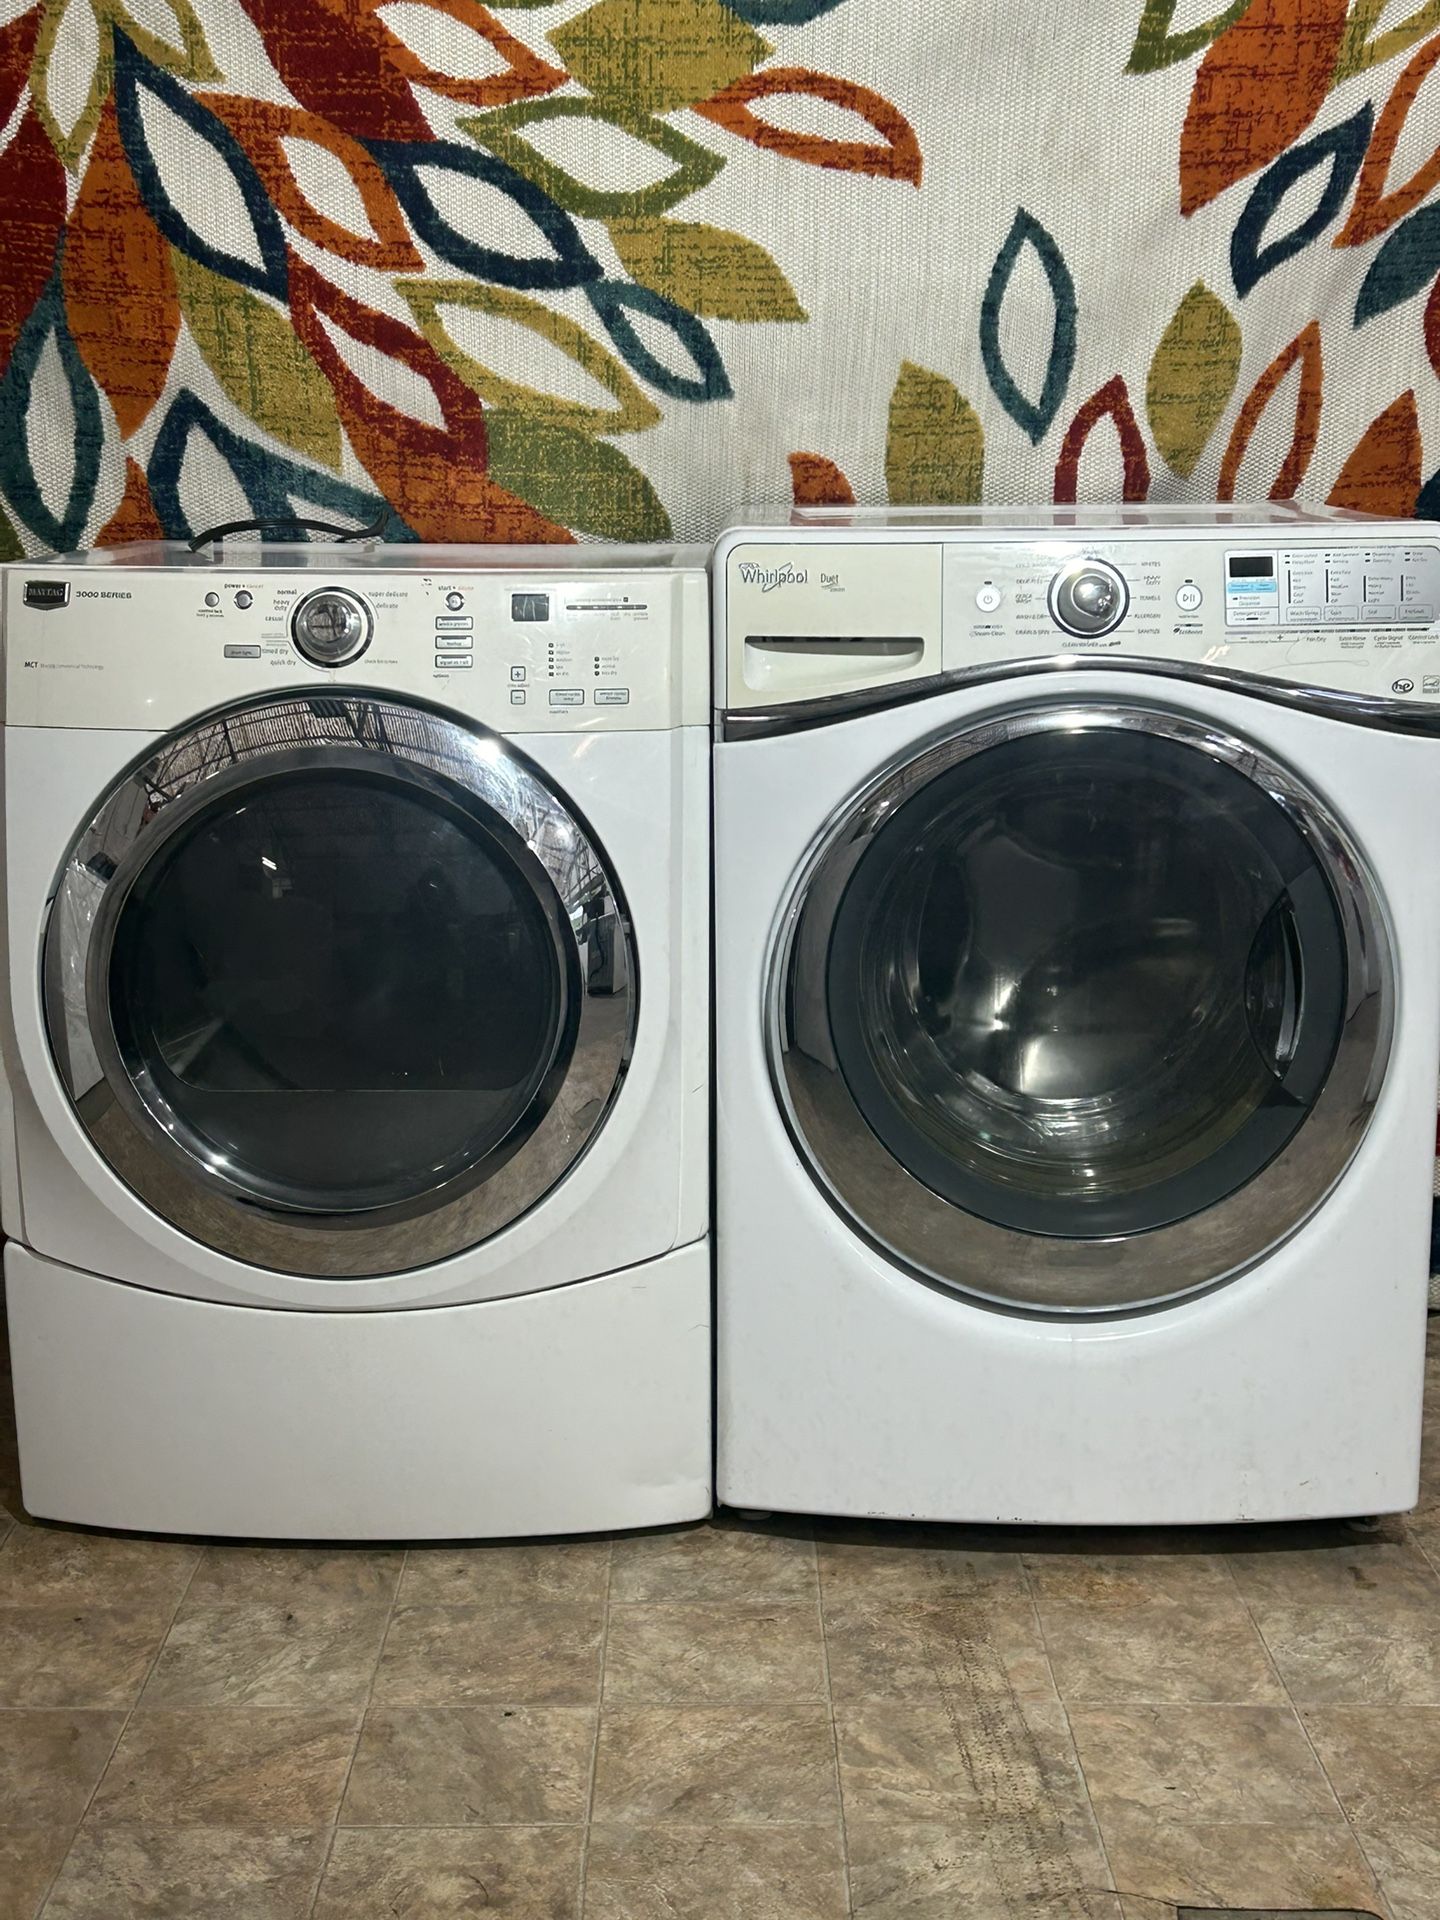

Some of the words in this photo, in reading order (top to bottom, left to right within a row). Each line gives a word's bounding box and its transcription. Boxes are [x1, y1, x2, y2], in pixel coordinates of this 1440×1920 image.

[740, 566, 808, 590] Whirlpool
[820, 573, 839, 584] Duet
[28, 588, 64, 597] MAYTAG
[75, 590, 99, 598] 3000
[100, 591, 132, 600] SERIES
[280, 646, 289, 655] dry
[24, 661, 38, 669] MCT
[287, 658, 296, 666] dry
